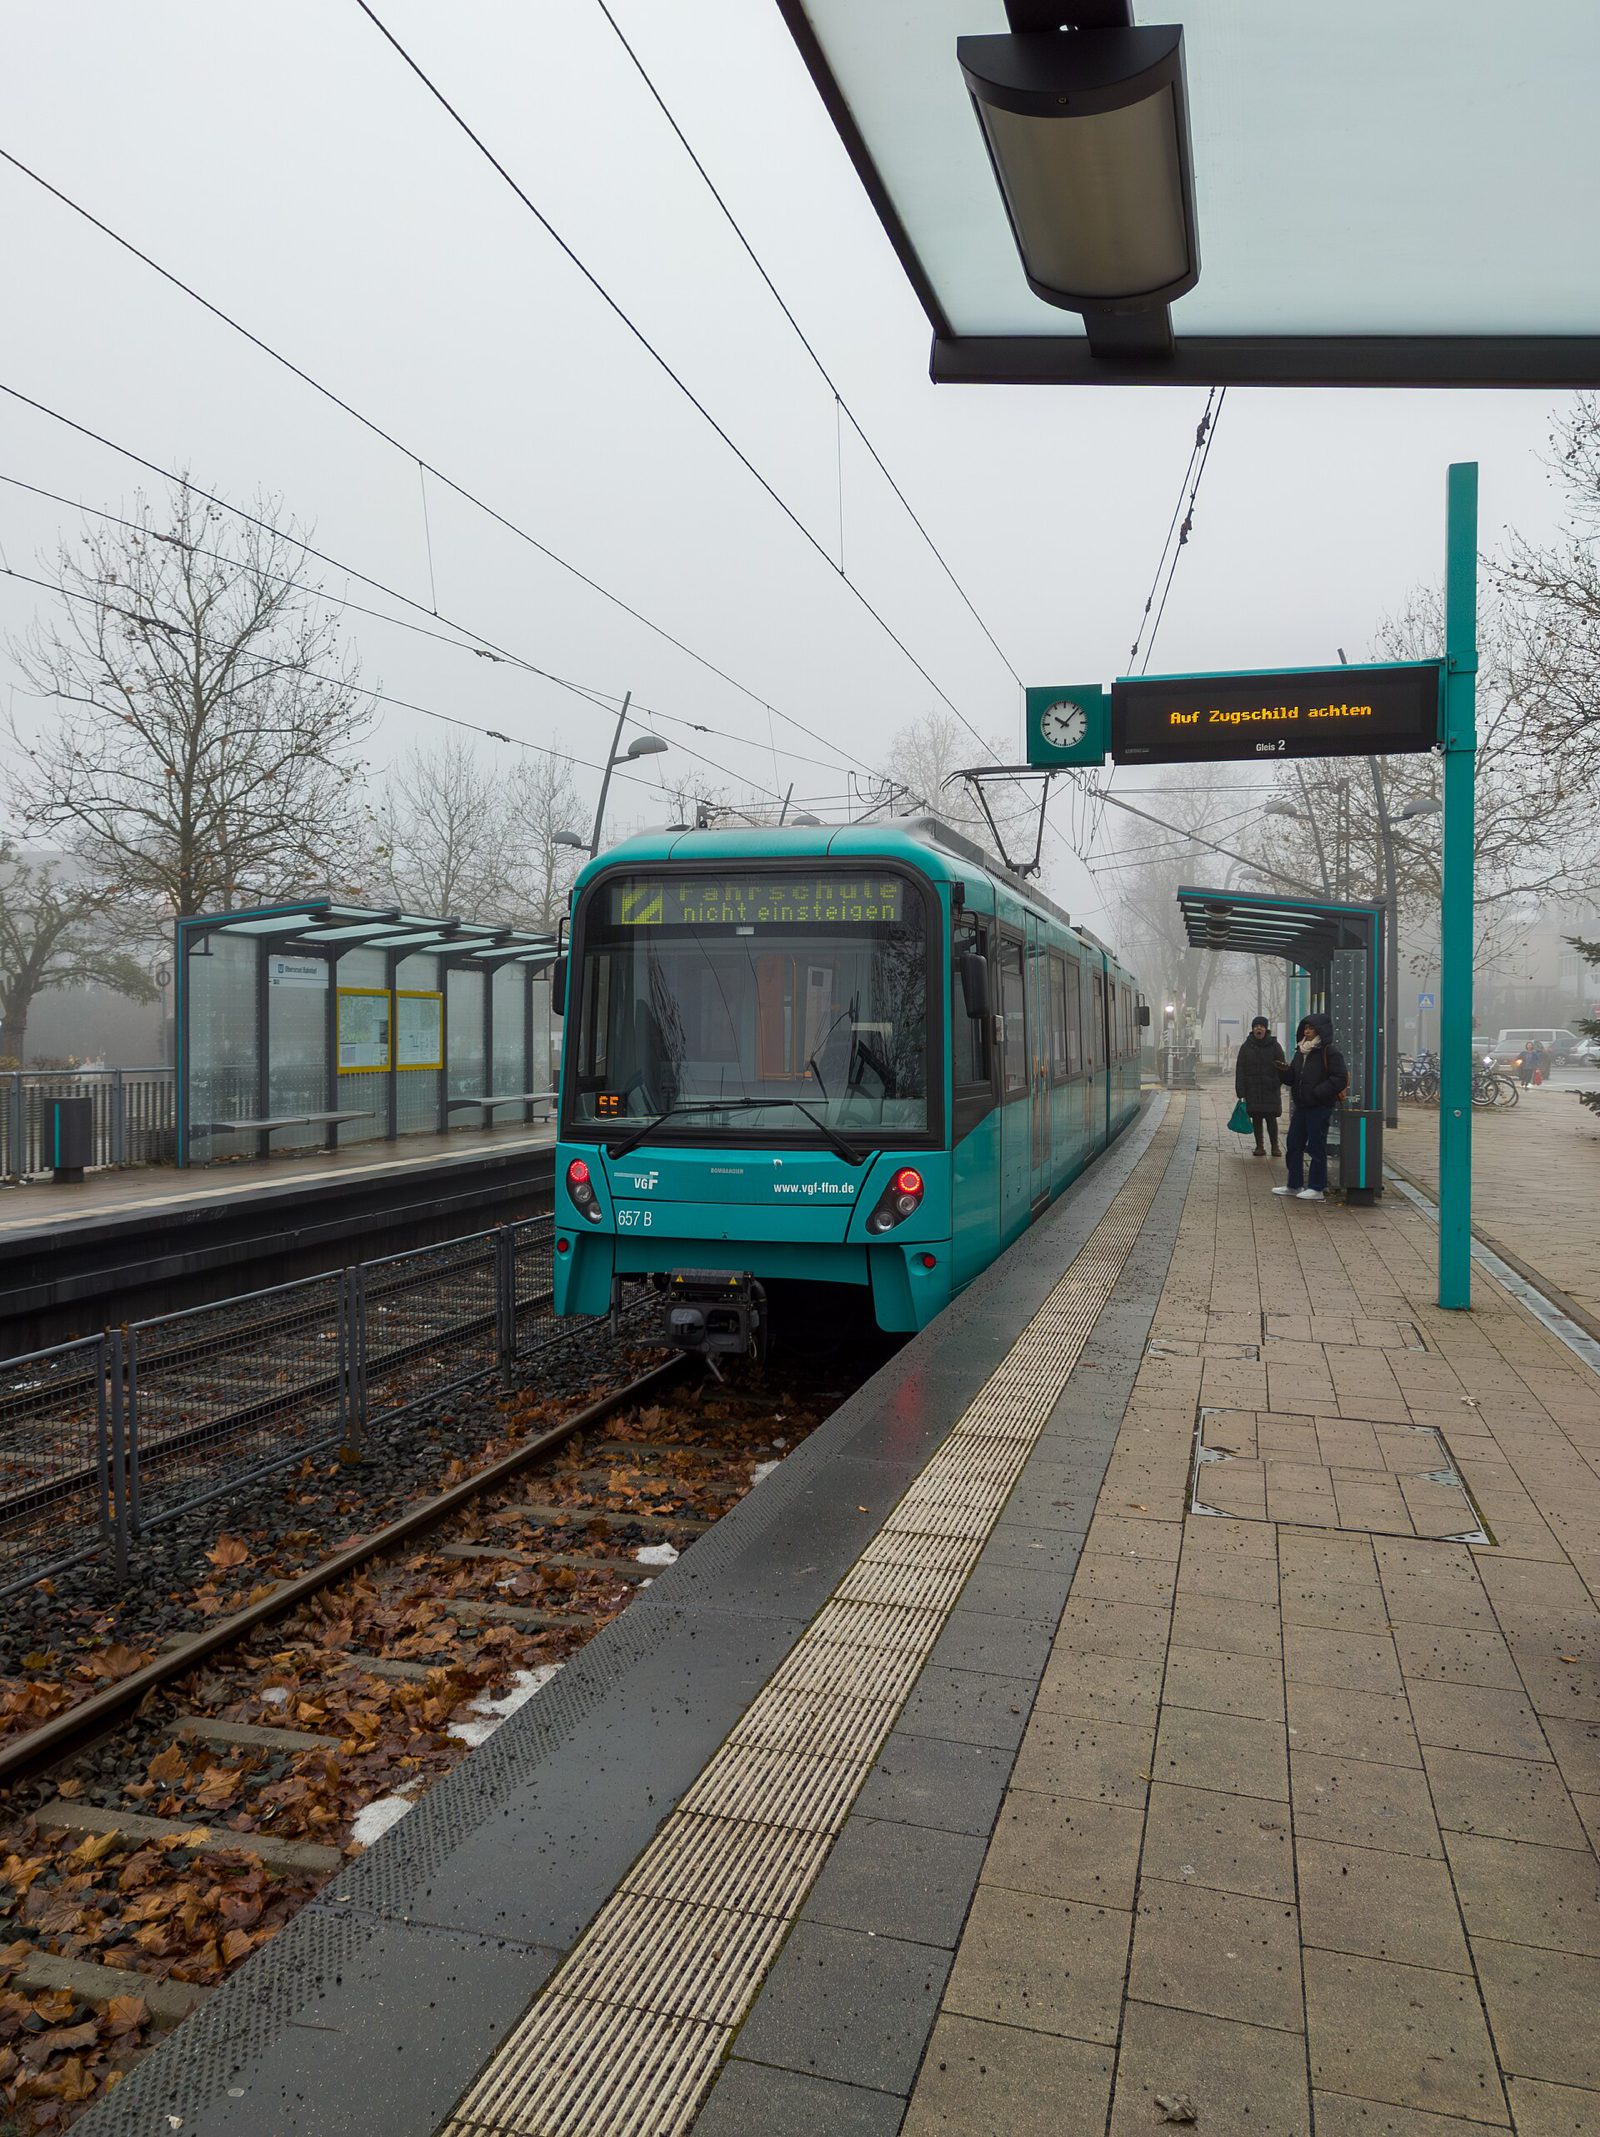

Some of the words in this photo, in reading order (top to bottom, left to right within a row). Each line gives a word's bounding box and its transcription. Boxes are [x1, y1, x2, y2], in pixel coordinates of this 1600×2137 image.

[1170, 711, 1200, 724] Auf
[1208, 706, 1299, 724] Zugschild
[1307, 704, 1372, 718] achten
[1256, 742, 1275, 751] Gleis
[1278, 739, 1286, 751] 2
[679, 879, 898, 901] Fahrschule
[683, 901, 746, 921] nicht
[757, 900, 896, 921] einsteigen
[634, 1171, 659, 1190] VGF
[773, 1181, 855, 1196] www.vgf-ffm.de
[618, 1210, 641, 1227] 657
[643, 1211, 652, 1227] B
